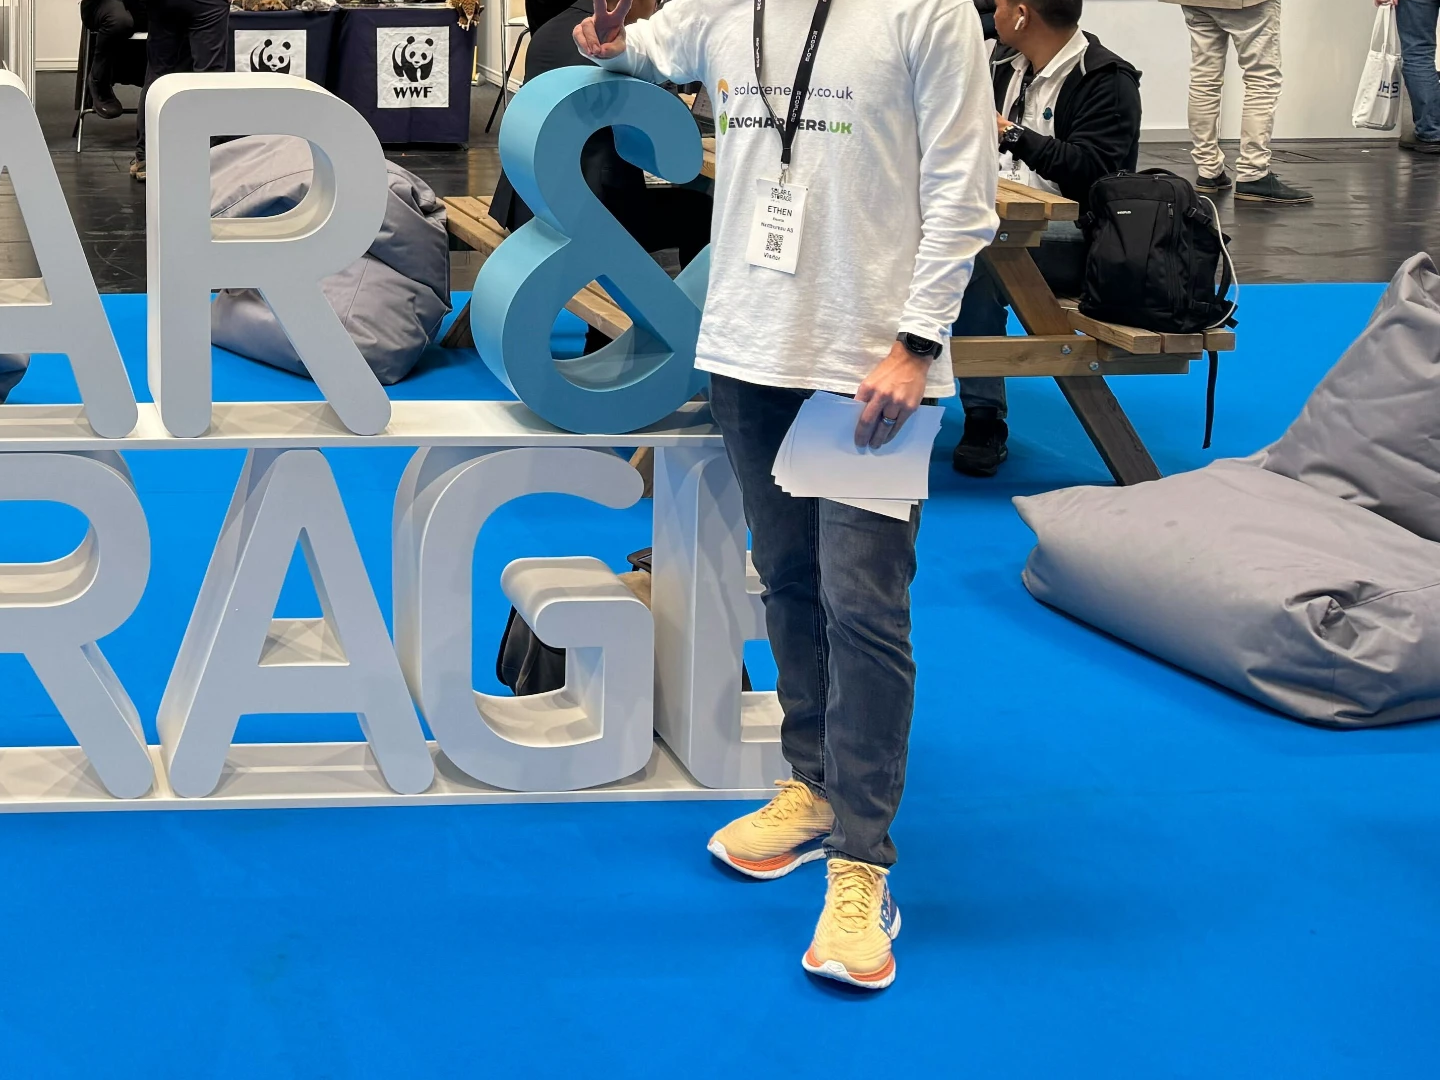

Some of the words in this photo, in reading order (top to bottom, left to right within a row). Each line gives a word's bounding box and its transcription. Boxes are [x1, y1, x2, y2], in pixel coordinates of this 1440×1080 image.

[393, 86, 433, 99] WWF
[734, 82, 853, 100] solaeney.co.uk
[728, 116, 852, 134] EVCHARERS.UK
[767, 206, 792, 216] ETHEN
[471, 65, 711, 435] &
